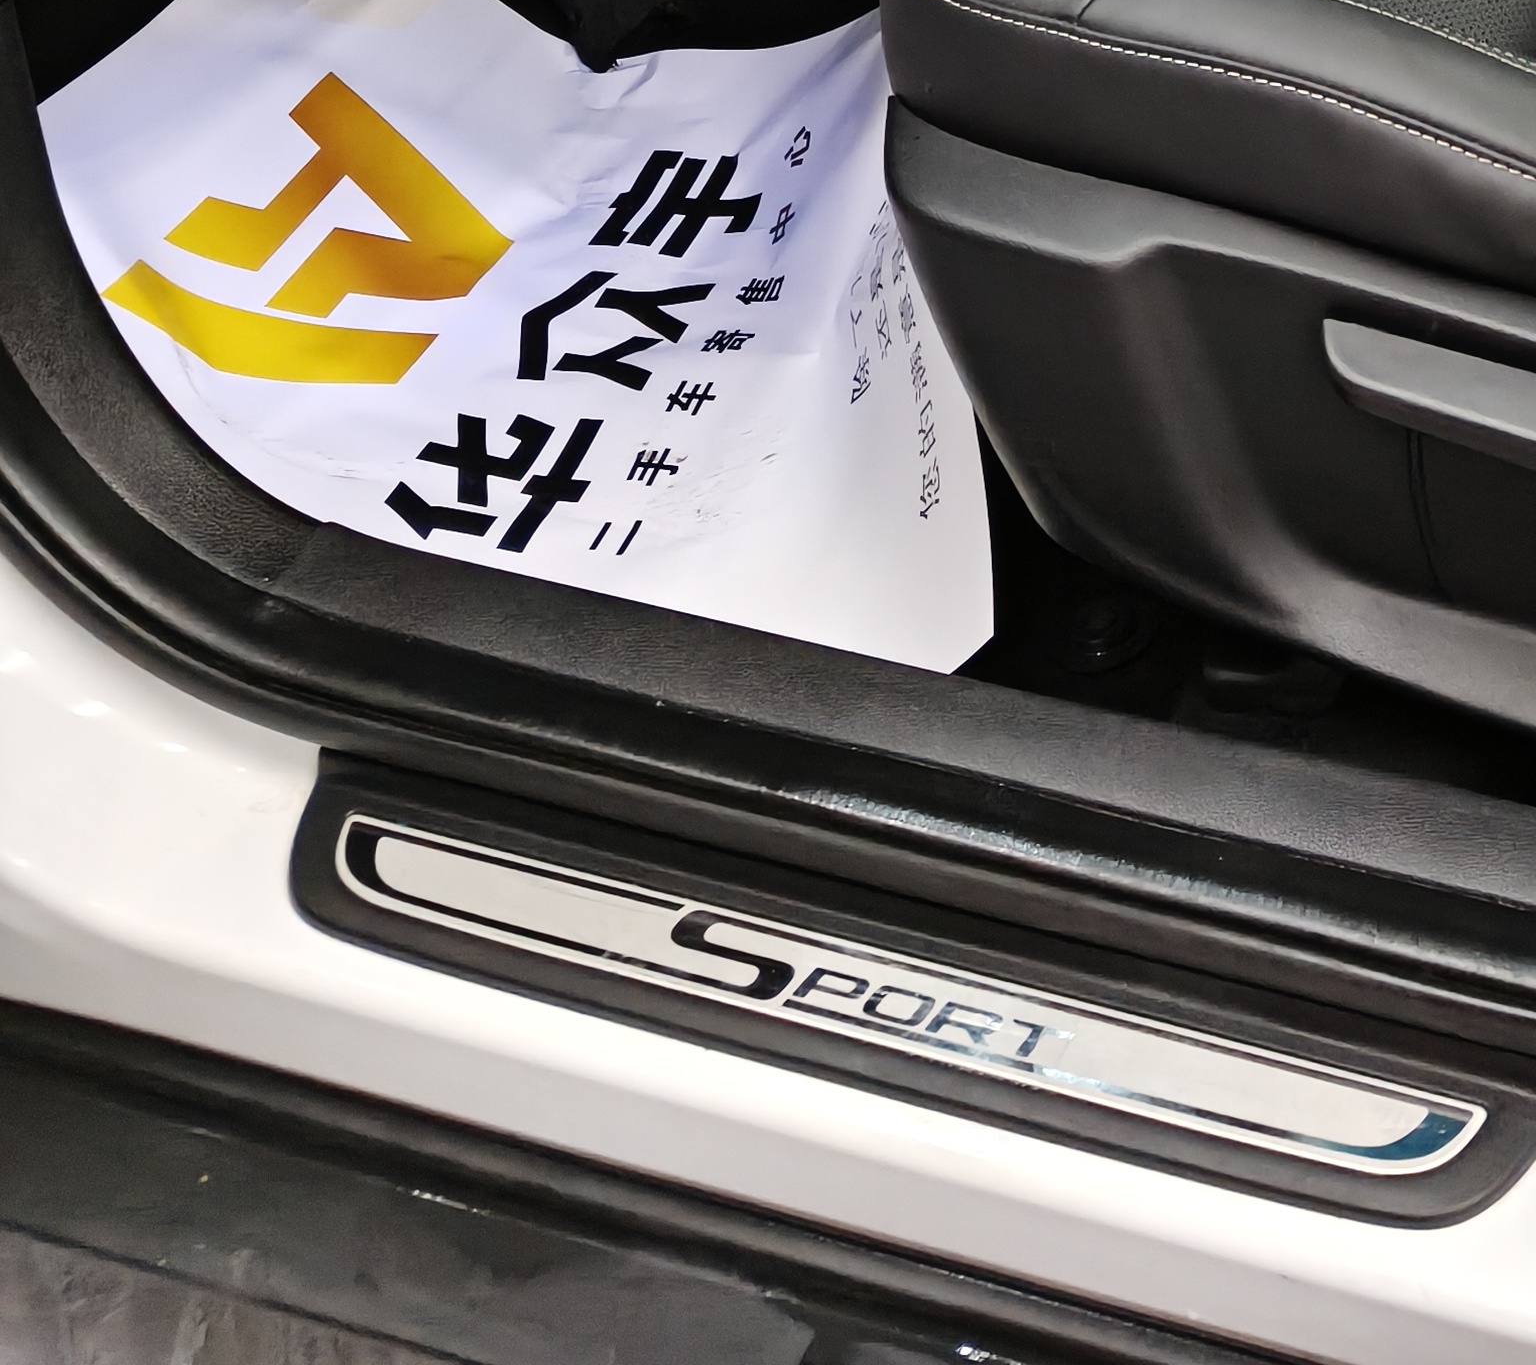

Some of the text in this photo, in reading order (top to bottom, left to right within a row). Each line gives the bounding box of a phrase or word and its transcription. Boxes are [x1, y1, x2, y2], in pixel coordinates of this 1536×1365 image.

[384, 149, 763, 553] 华众宇
[588, 125, 812, 556] 二手车寄售中心
